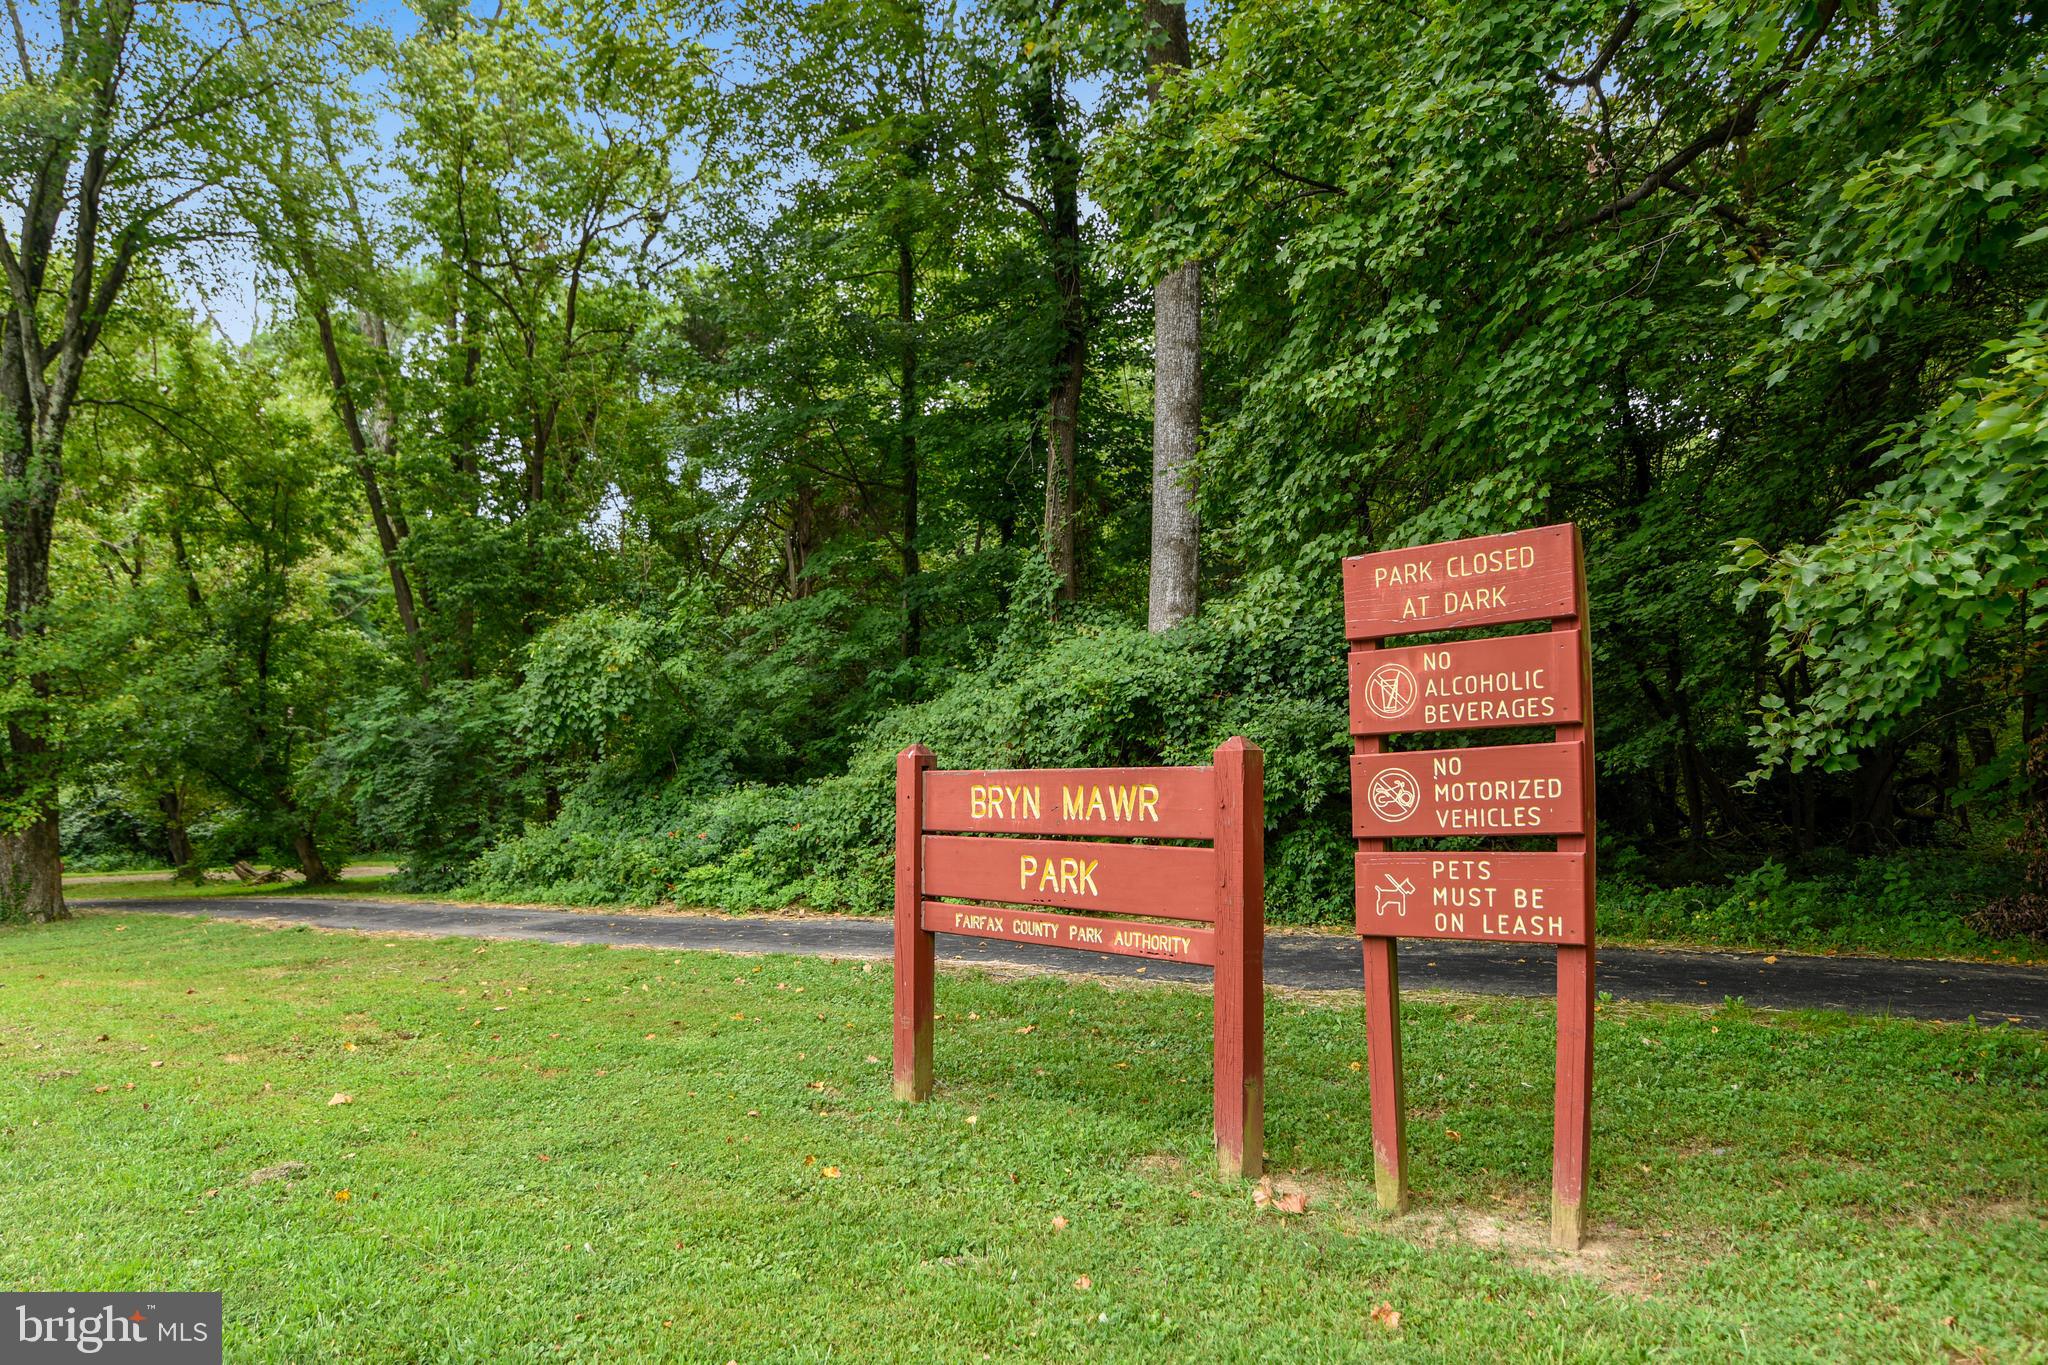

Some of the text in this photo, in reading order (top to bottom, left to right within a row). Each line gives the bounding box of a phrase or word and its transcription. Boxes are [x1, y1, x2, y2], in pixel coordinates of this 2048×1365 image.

[1375, 546, 1534, 588] PARK CLOSED
[1402, 586, 1506, 619] AT DARK
[1423, 652, 1450, 671] NO
[1425, 670, 1544, 696] ALCOHOLIC
[1424, 697, 1554, 724] BEVERAGES
[1434, 756, 1462, 776] NO
[1435, 778, 1562, 802] MOTORIZED
[970, 784, 1159, 822] BRYN MAWR
[1436, 807, 1541, 828] VEHICLES
[1020, 855, 1098, 896] PARK
[1432, 860, 1491, 880] PETS
[1433, 887, 1544, 909] MUST BE
[955, 912, 1191, 954] FAIRFAX COUNTY PARK AUTHORITY
[1435, 913, 1562, 936] ON LEASH
